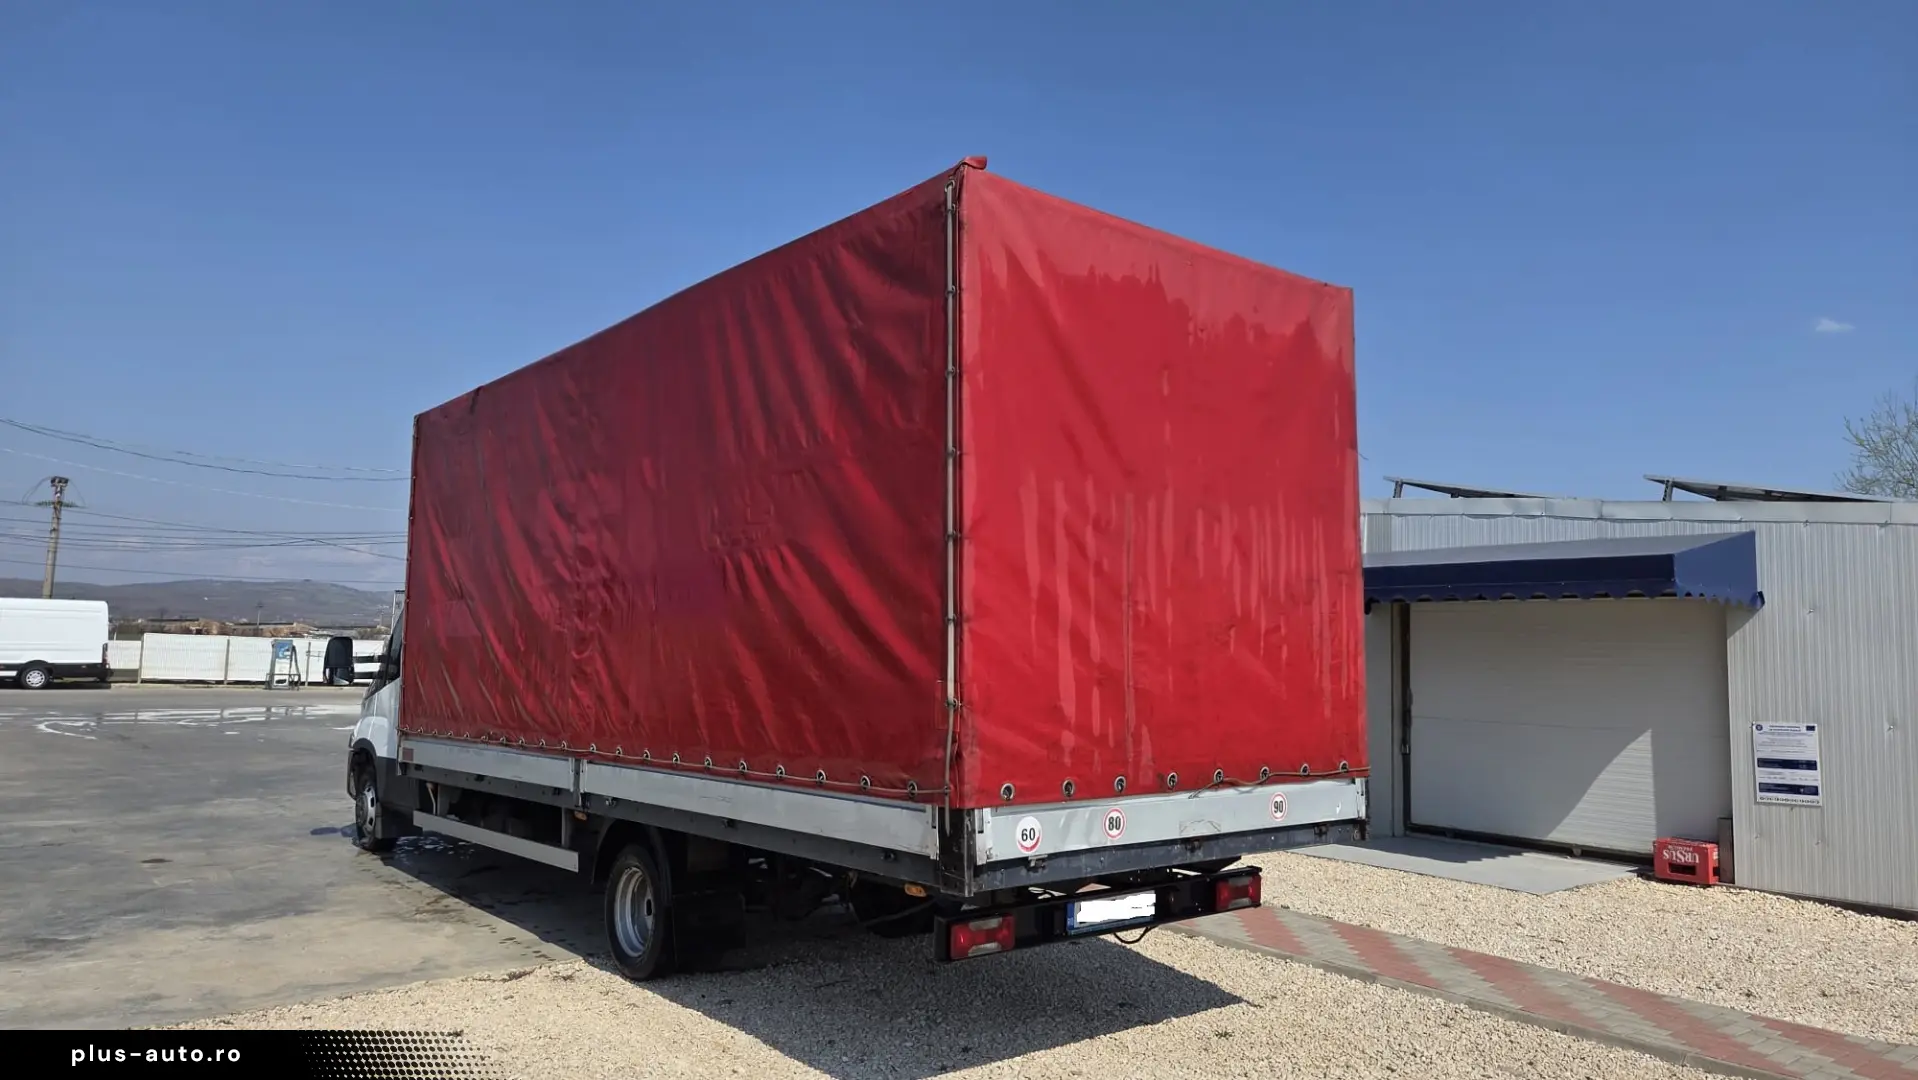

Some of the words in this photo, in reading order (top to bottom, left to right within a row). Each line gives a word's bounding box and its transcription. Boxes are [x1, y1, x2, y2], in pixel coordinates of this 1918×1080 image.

[1273, 800, 1284, 814] 90
[1107, 816, 1122, 831] 80
[1021, 827, 1036, 842] 60
